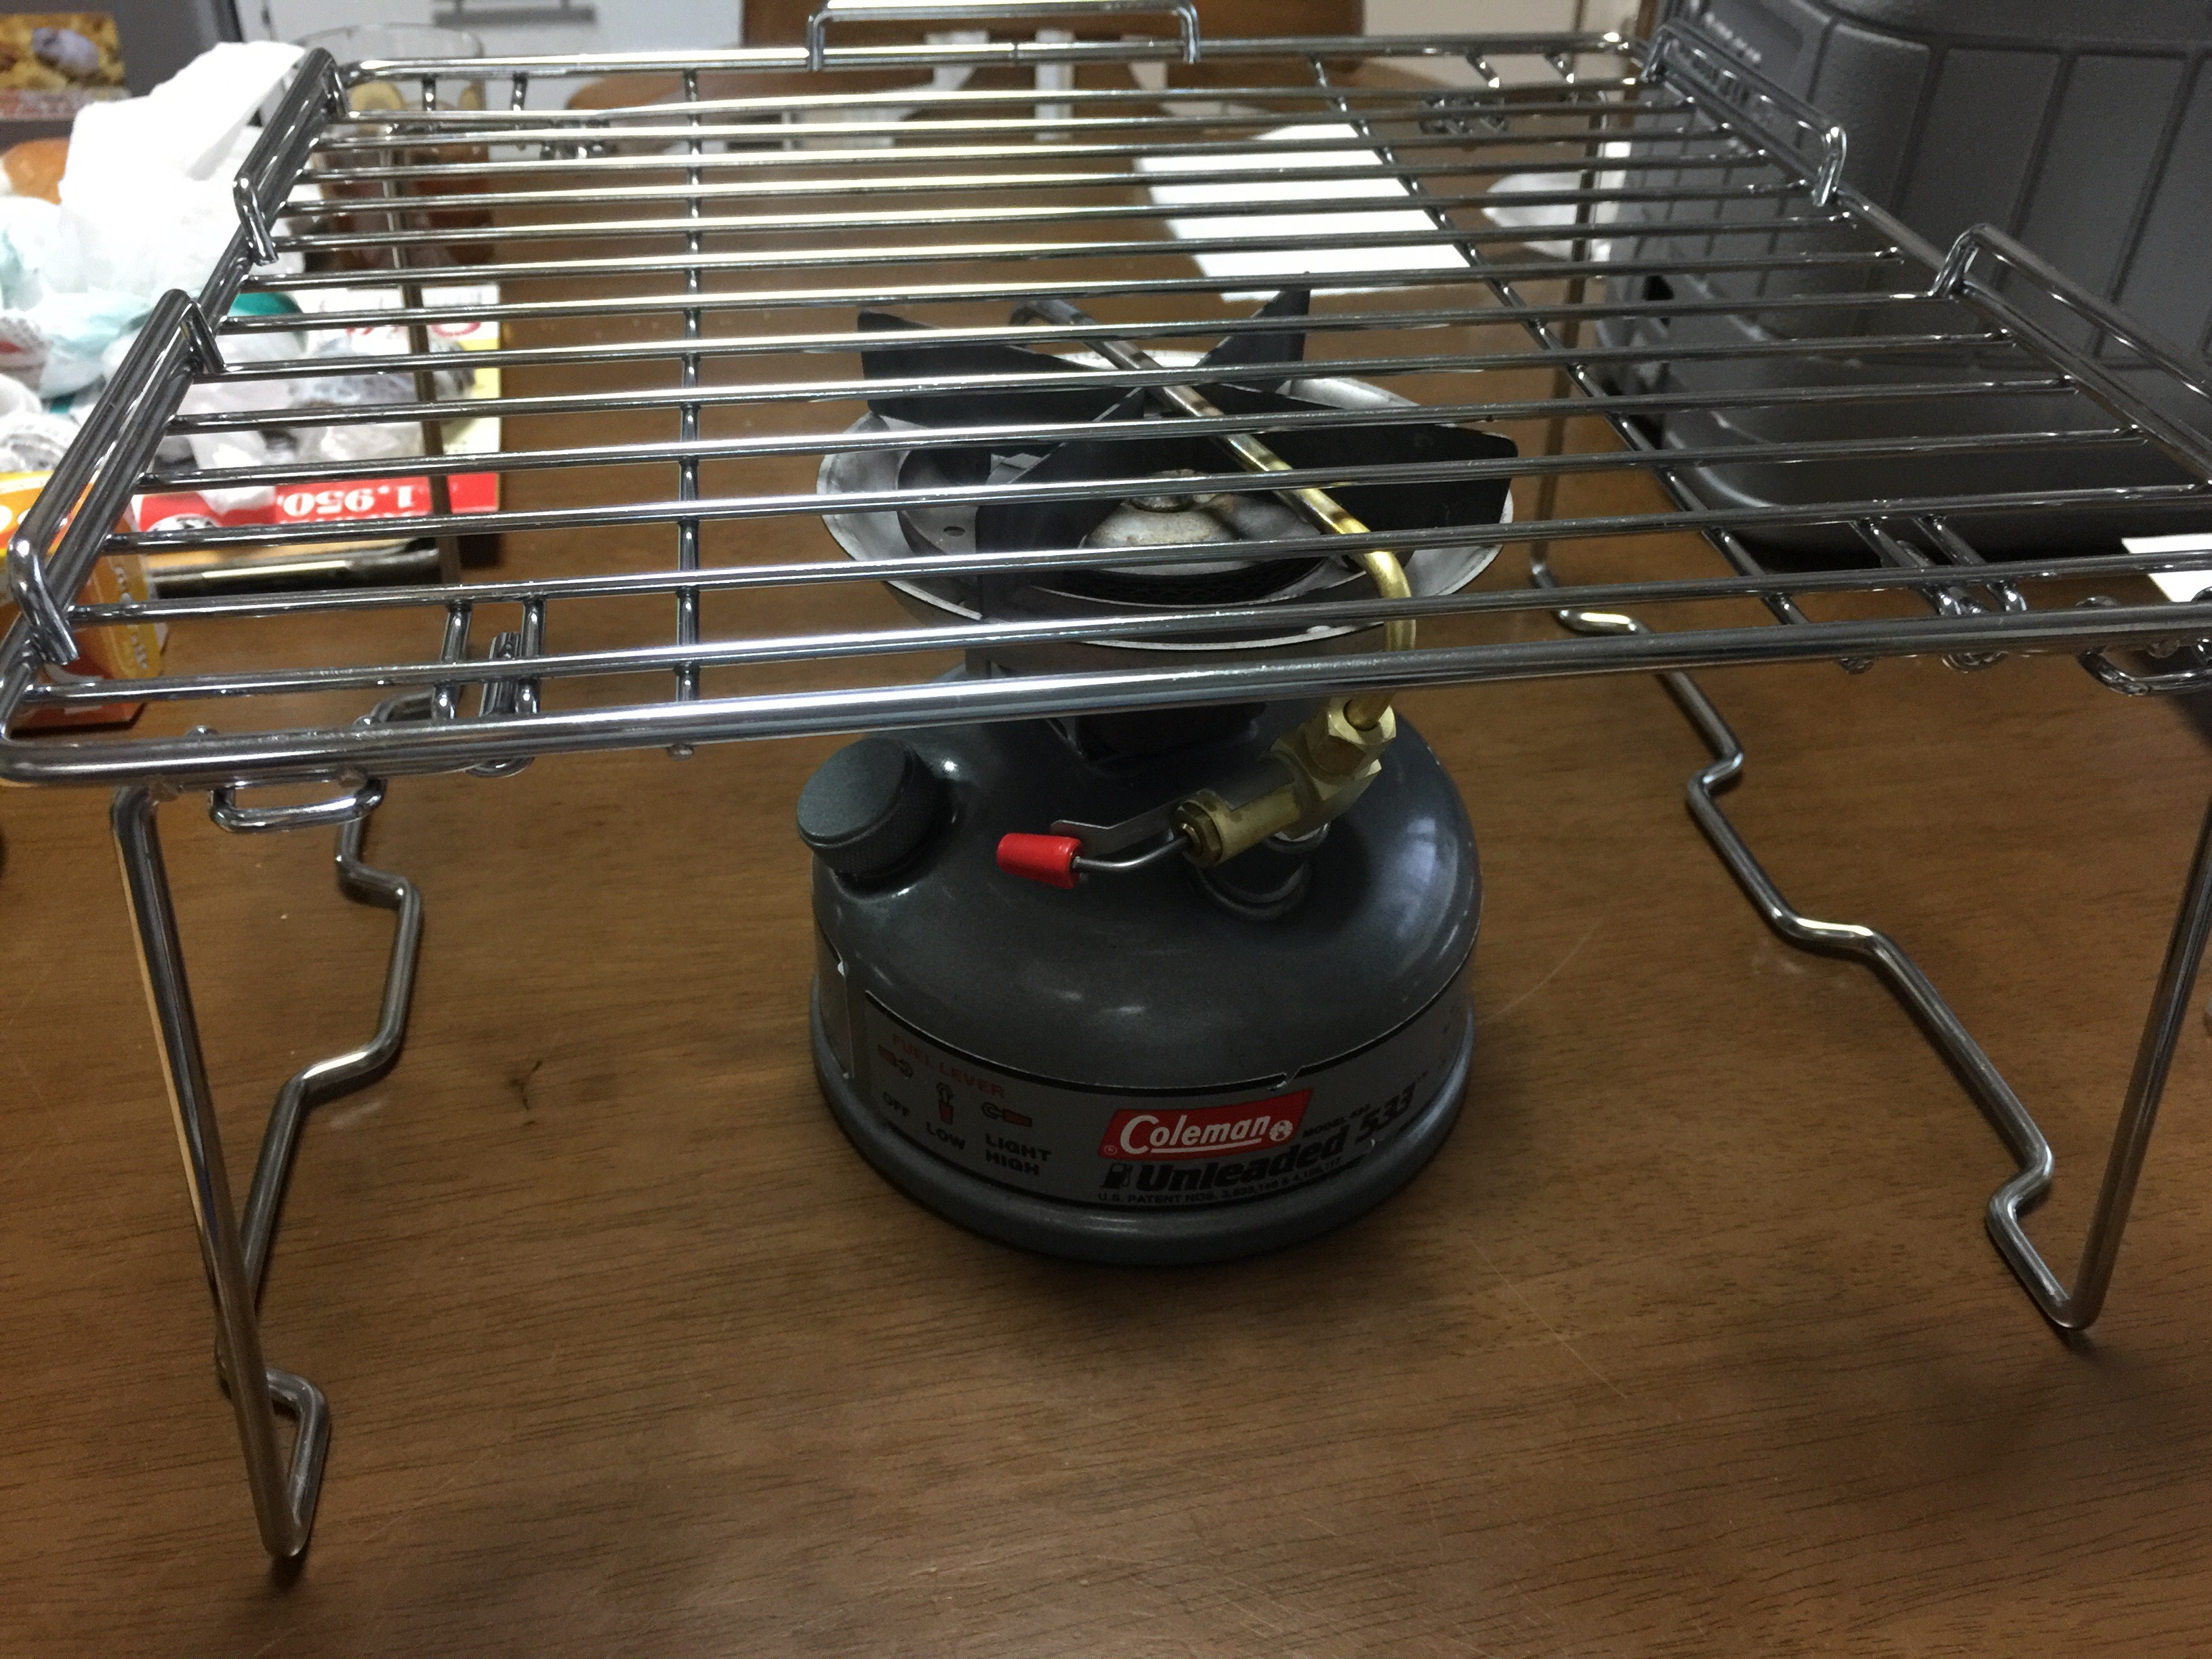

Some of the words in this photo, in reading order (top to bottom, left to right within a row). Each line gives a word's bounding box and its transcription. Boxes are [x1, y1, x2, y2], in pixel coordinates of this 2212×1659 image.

[892, 1032, 934, 1068] FUEL
[939, 1061, 1004, 1099] LEVER
[882, 1091, 910, 1117] OFF
[926, 1121, 966, 1150] LOW
[1120, 1114, 1271, 1155] Coleman
[1135, 1124, 1351, 1191] Unleaded
[1355, 1082, 1416, 1145] 533
[1303, 1115, 1347, 1139] MODEL
[985, 1133, 1052, 1162] LIGHT
[985, 1149, 1040, 1176] HIGH
[1098, 1193, 1122, 1202] U.S.
[1128, 1194, 1182, 1204] PATENT
